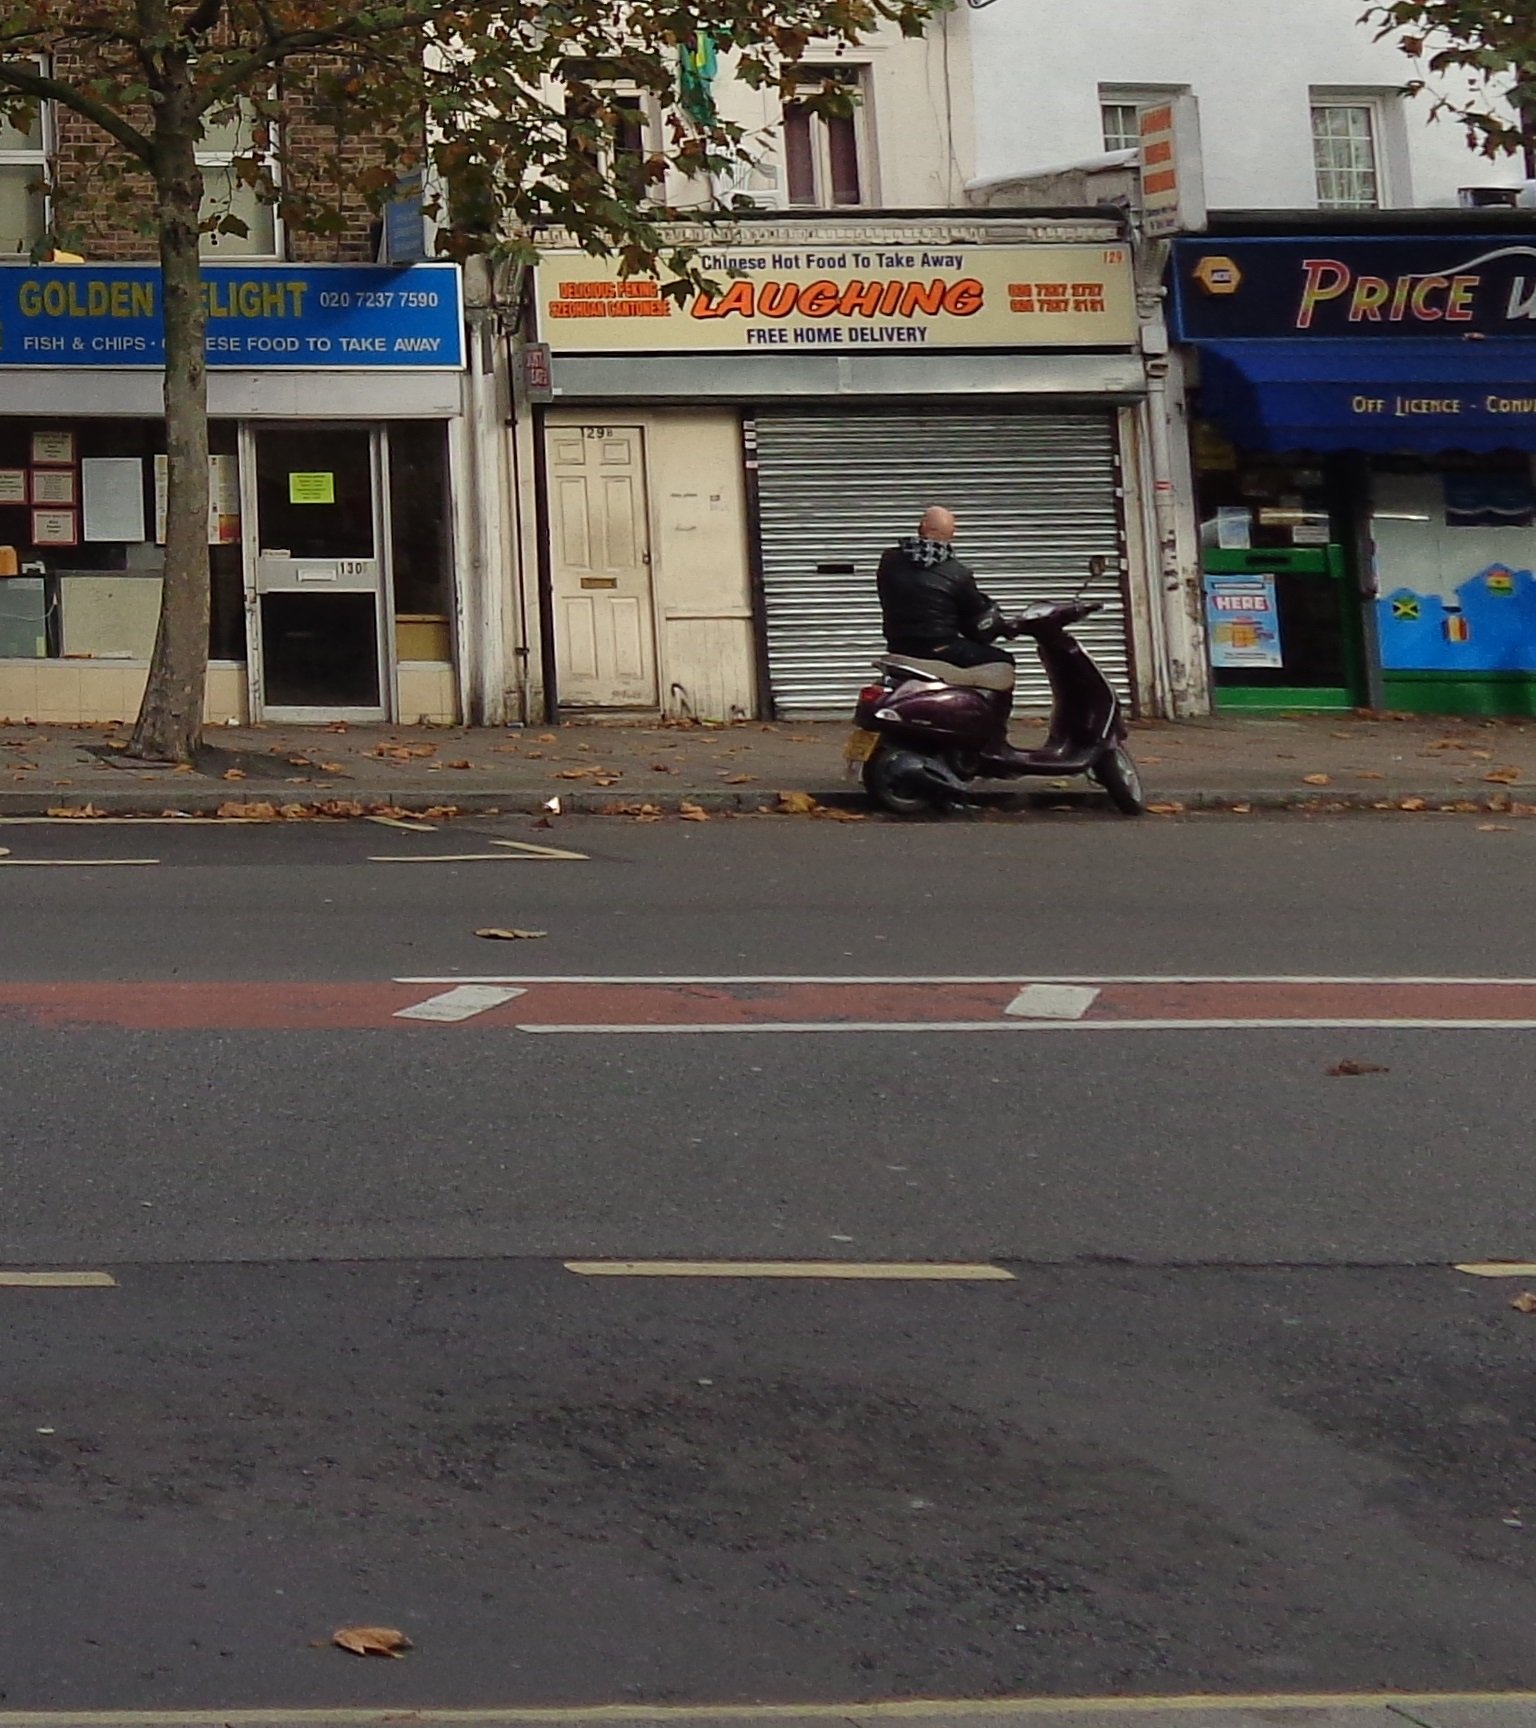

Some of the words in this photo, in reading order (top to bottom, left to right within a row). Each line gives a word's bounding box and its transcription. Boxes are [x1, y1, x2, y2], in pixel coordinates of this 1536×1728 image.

[702, 254, 766, 270] Chinese
[772, 254, 799, 269] Hot
[806, 254, 847, 269] Food
[852, 254, 871, 268] To
[876, 253, 915, 268] Take
[921, 252, 963, 270] Away
[1103, 251, 1123, 263] 129
[18, 280, 154, 317] GOLDEN
[199, 281, 308, 318] ELIGHT
[319, 292, 350, 308] 020
[356, 292, 394, 308] 7237
[399, 292, 439, 308] 7590
[690, 278, 985, 319] LAUGHING
[1296, 258, 1481, 329] PRICE
[747, 328, 788, 344] FREE
[794, 327, 843, 343] HOME
[849, 327, 927, 343] DELIVERY
[23, 336, 65, 351] FISH
[71, 336, 85, 351] &
[92, 336, 146, 351] CHIPS
[247, 337, 299, 352] FOOD
[305, 337, 331, 352] TO
[338, 337, 387, 352] TAKE
[393, 337, 442, 352] AWAY
[340, 562, 363, 575] 130
[1215, 596, 1266, 611] HERE
